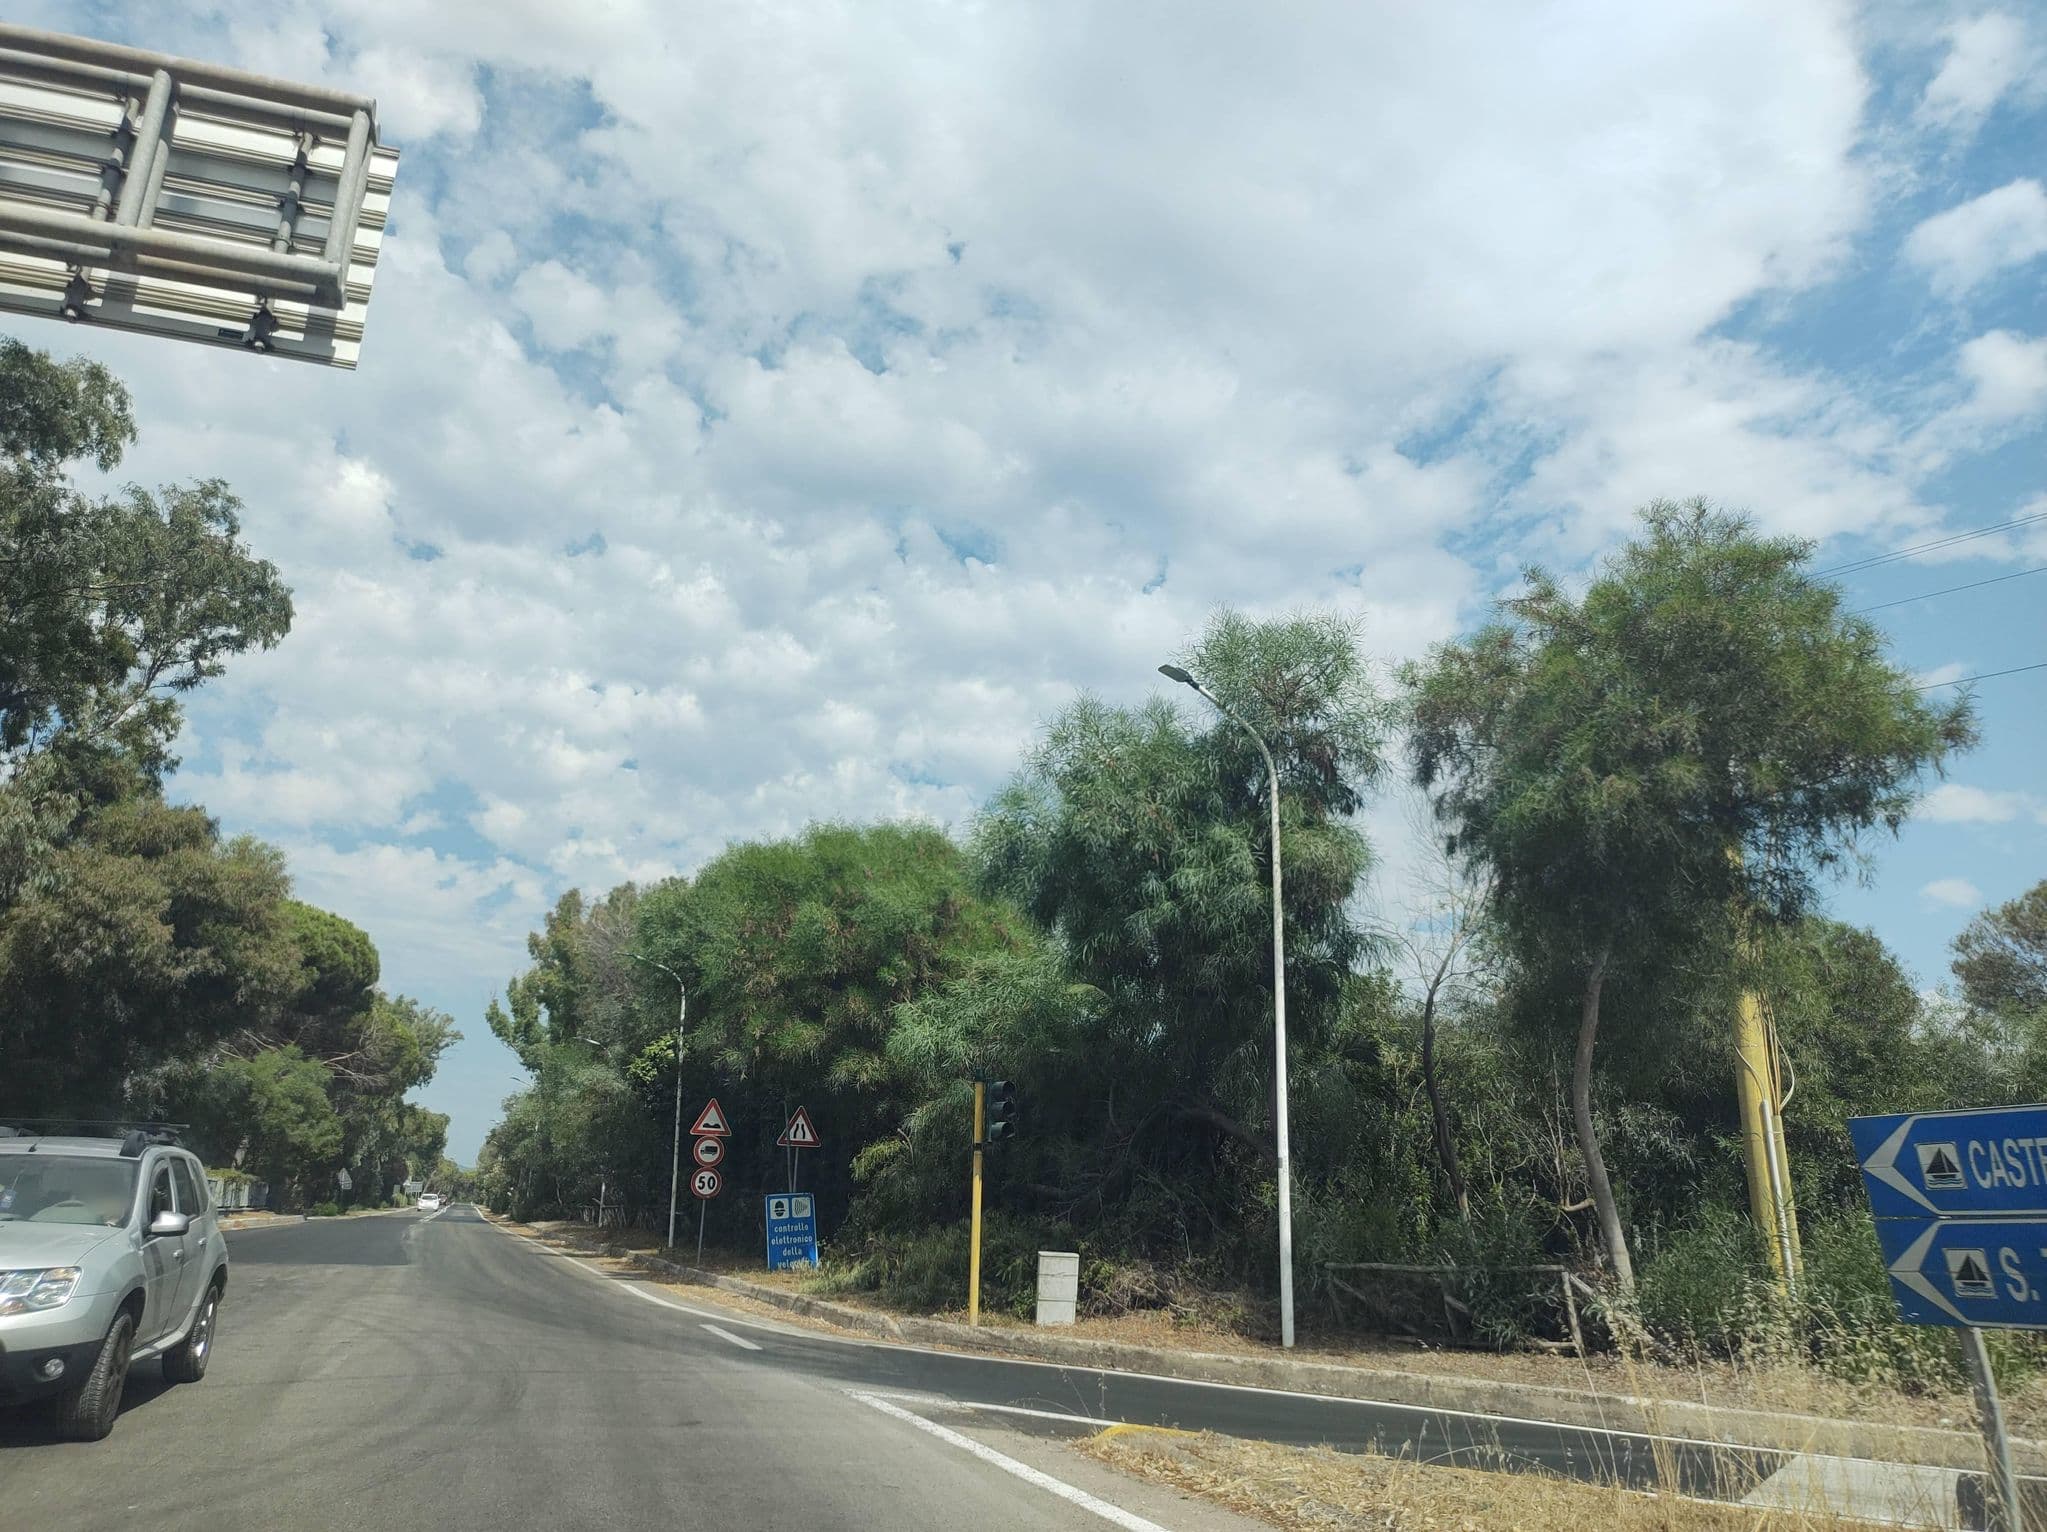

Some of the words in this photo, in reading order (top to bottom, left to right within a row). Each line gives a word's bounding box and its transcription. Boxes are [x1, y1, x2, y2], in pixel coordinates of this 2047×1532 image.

[697, 1175, 716, 1190] 50
[774, 1222, 809, 1233] controllo
[771, 1235, 813, 1246] elettronico
[782, 1246, 803, 1257] della
[1999, 1246, 2041, 1302] S.
